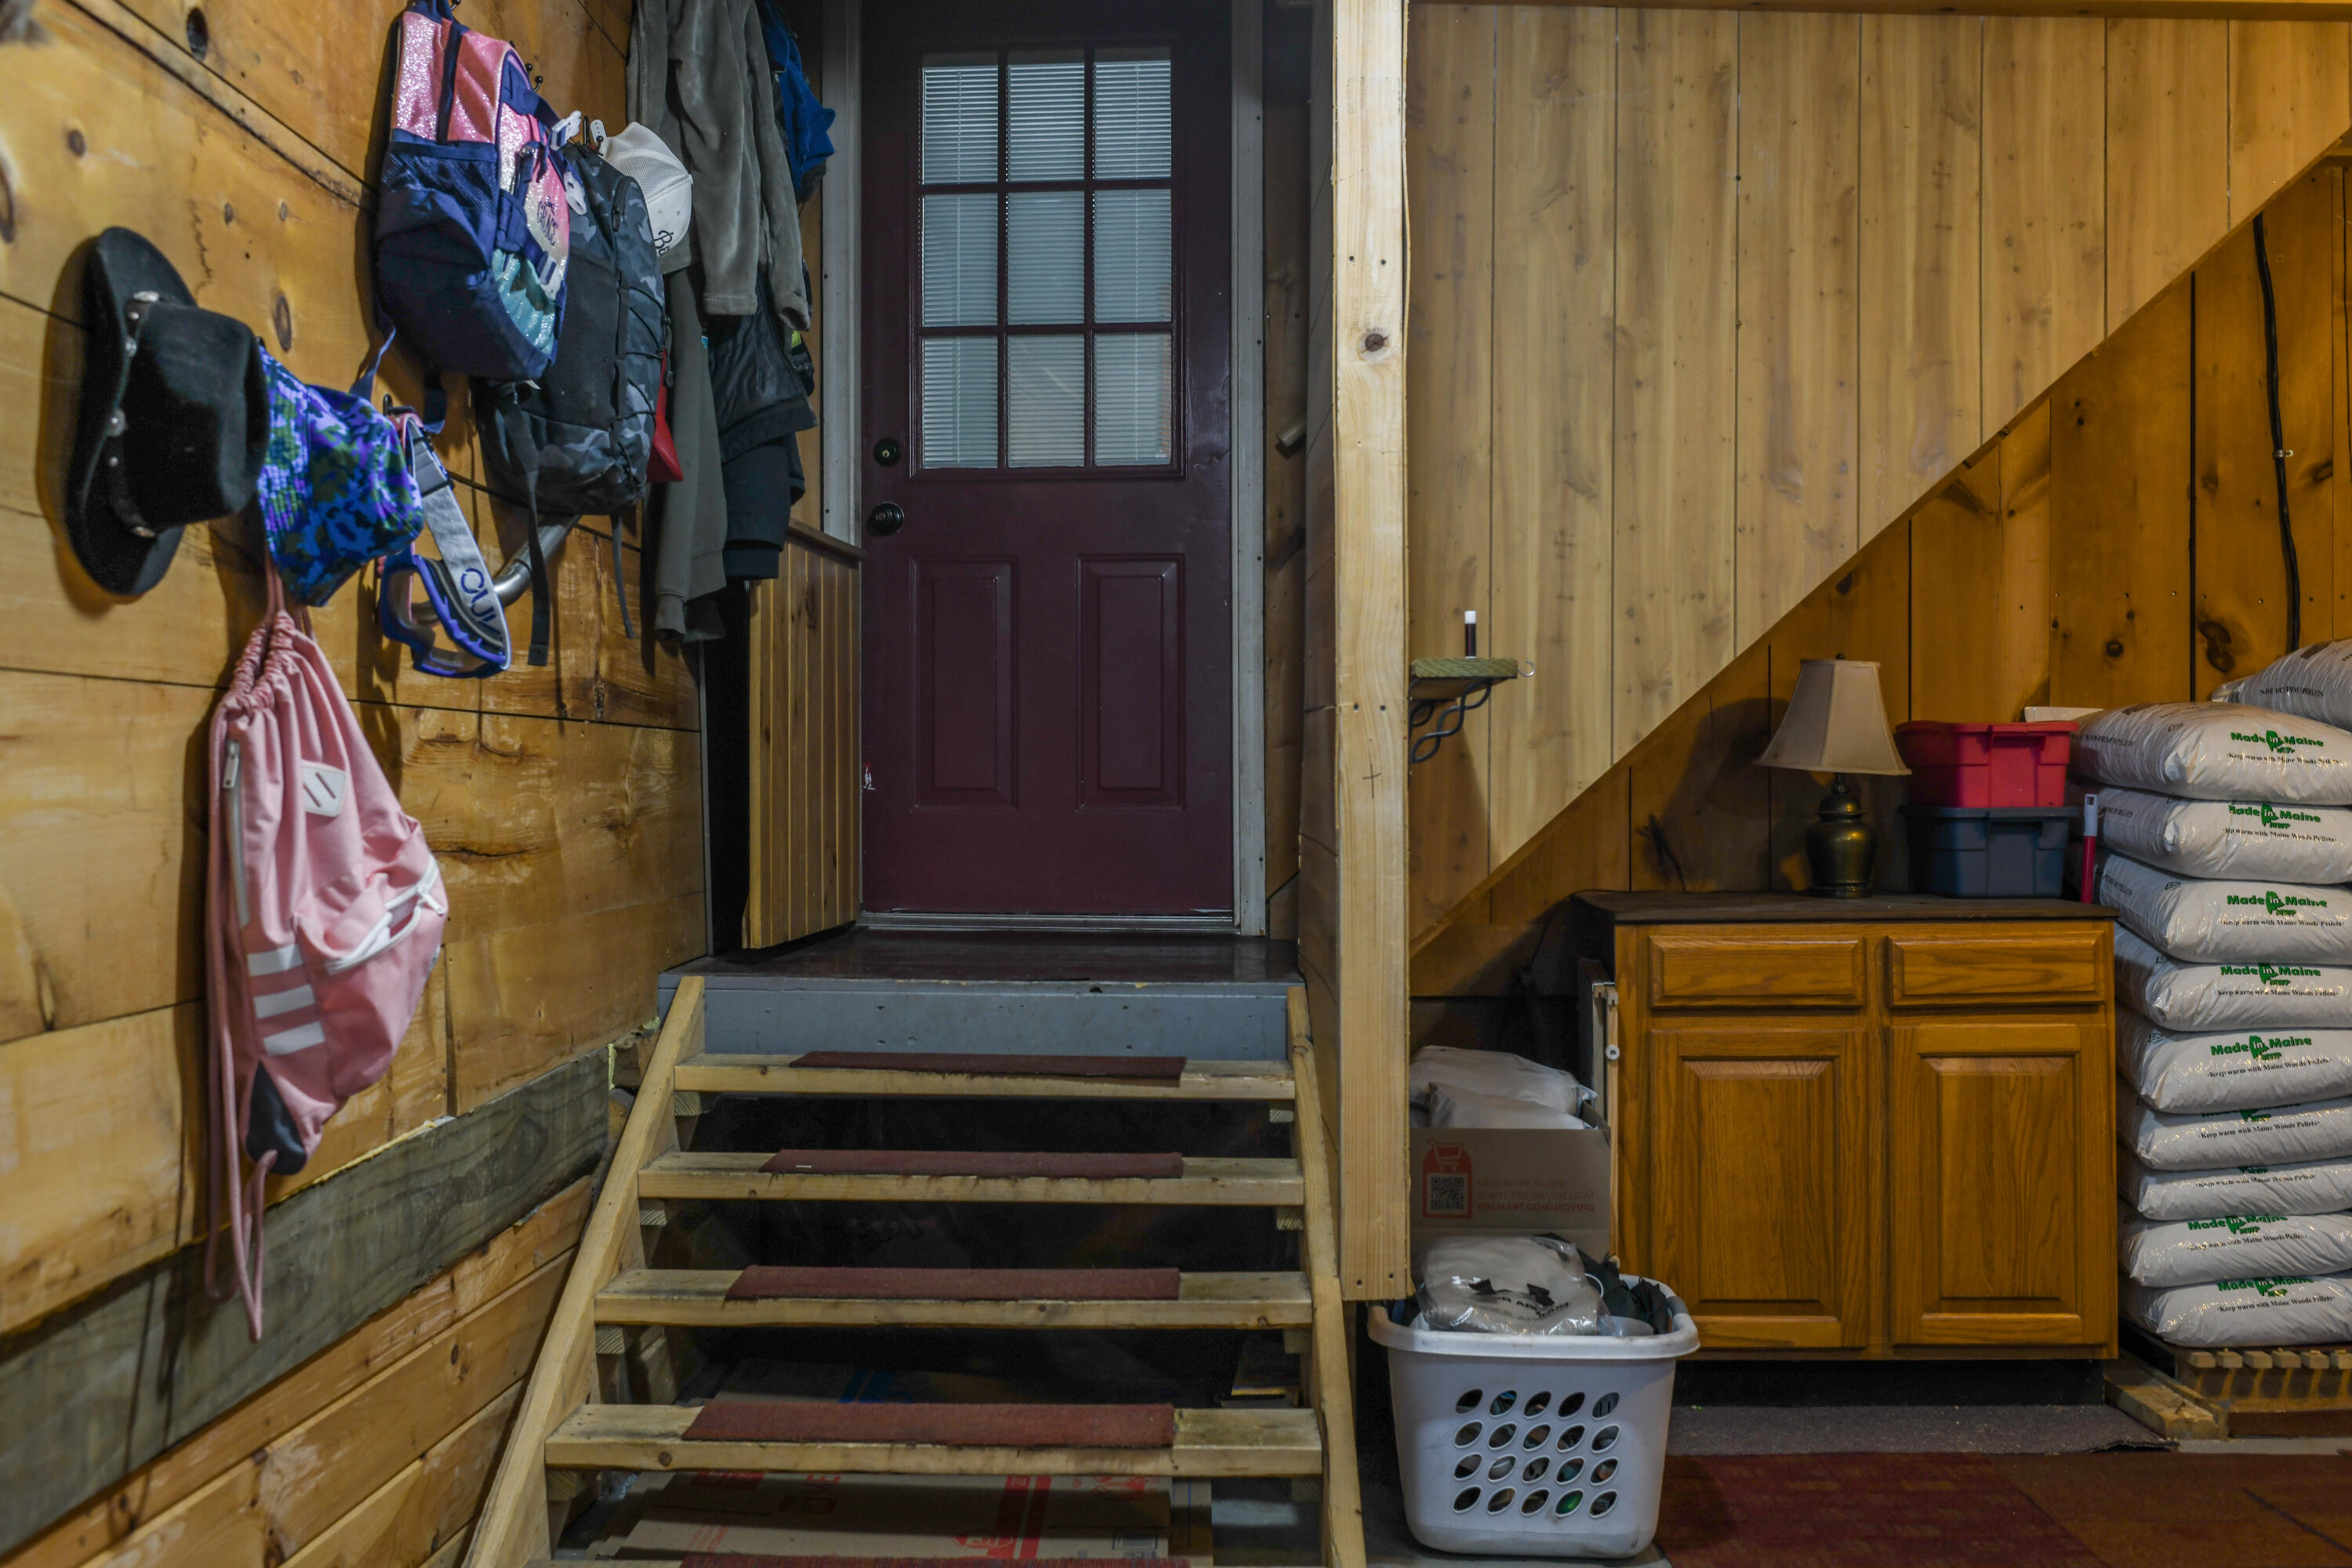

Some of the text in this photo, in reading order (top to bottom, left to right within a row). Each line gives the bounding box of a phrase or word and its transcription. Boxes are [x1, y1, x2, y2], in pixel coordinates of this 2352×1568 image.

[2230, 731, 2266, 743] Made
[2284, 735, 2324, 747] Maine
[2279, 810, 2321, 823] Maine
[2227, 895, 2265, 906] Made
[2285, 896, 2328, 908] Maine
[2220, 965, 2259, 976] Made
[2278, 965, 2321, 977] Maine
[2210, 1041, 2249, 1056] Made
[2268, 1036, 2313, 1049] Maine
[1476, 1203, 1595, 1212] WALMART.COM/MOVING
[2187, 1218, 2226, 1231] Made
[2238, 1226, 2260, 1235] MWP
[2216, 1280, 2255, 1292] Made
